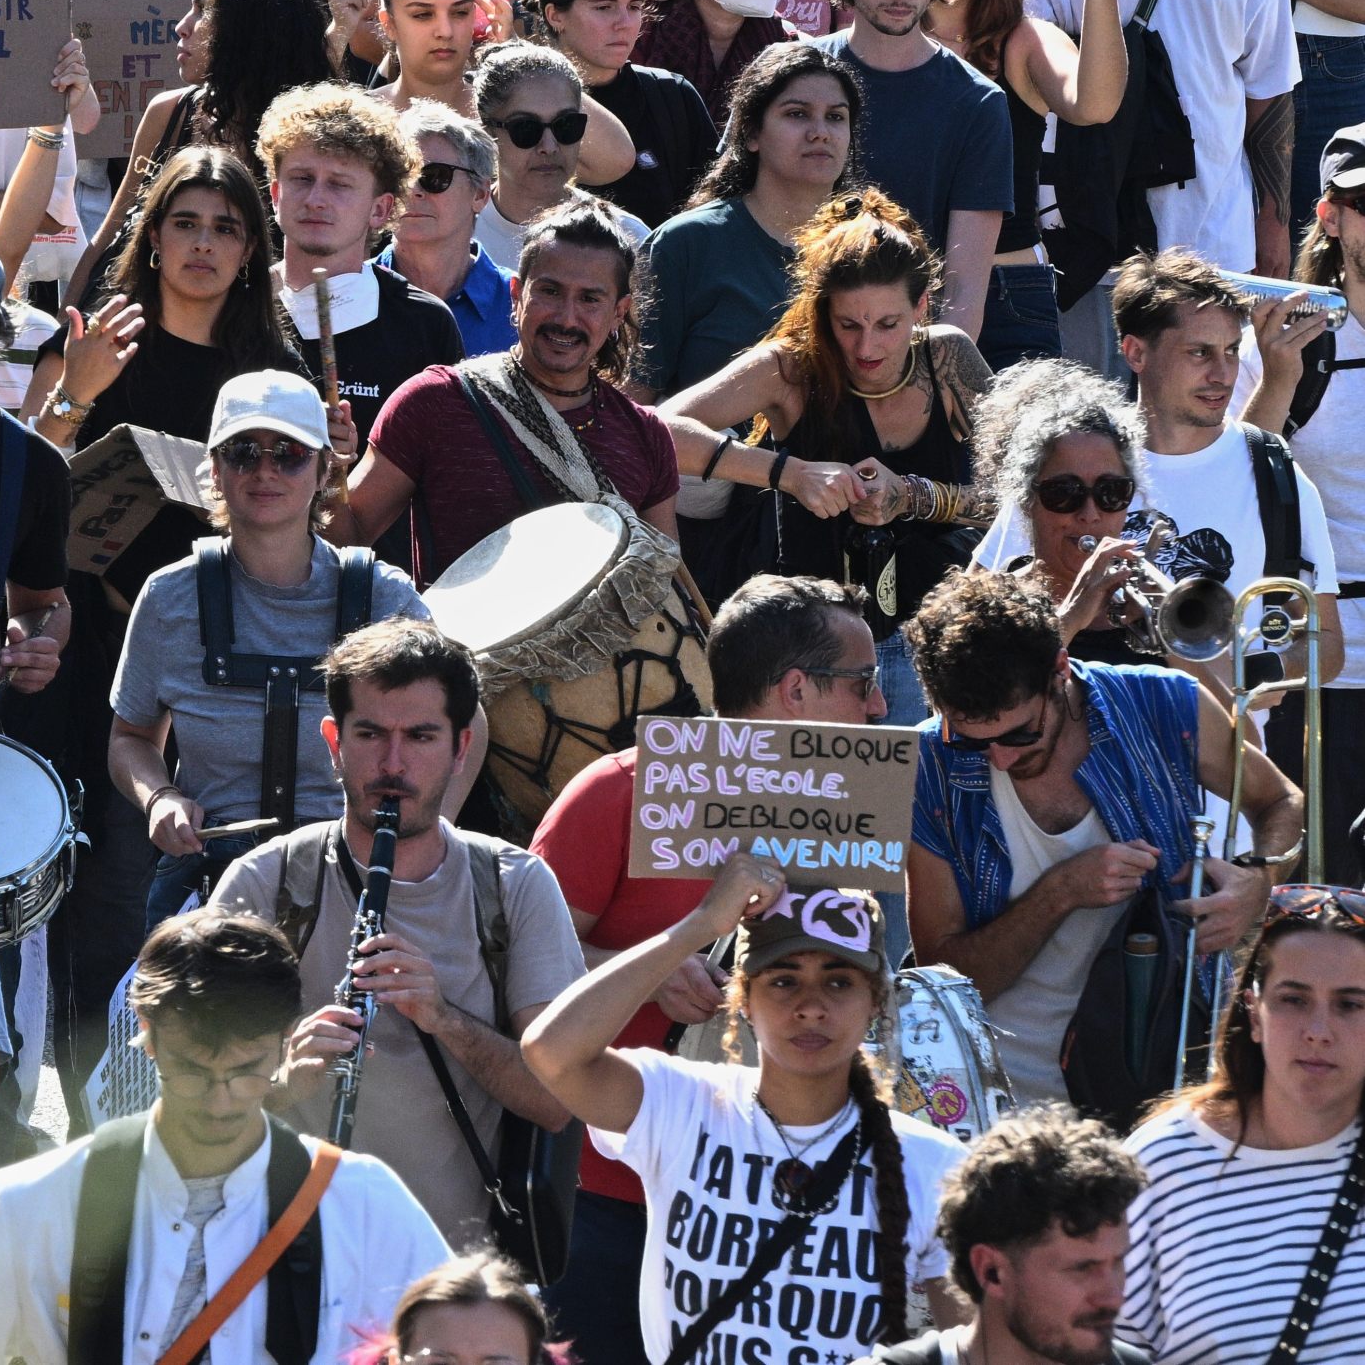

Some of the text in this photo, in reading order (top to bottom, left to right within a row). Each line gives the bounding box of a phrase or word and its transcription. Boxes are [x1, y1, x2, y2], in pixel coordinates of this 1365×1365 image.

[121, 53, 162, 79] ET
[643, 719, 914, 766] ON NE BLOQUE
[643, 761, 711, 795] PAS
[639, 799, 878, 839] ON DEBLOQUE
[650, 836, 741, 871] SON
